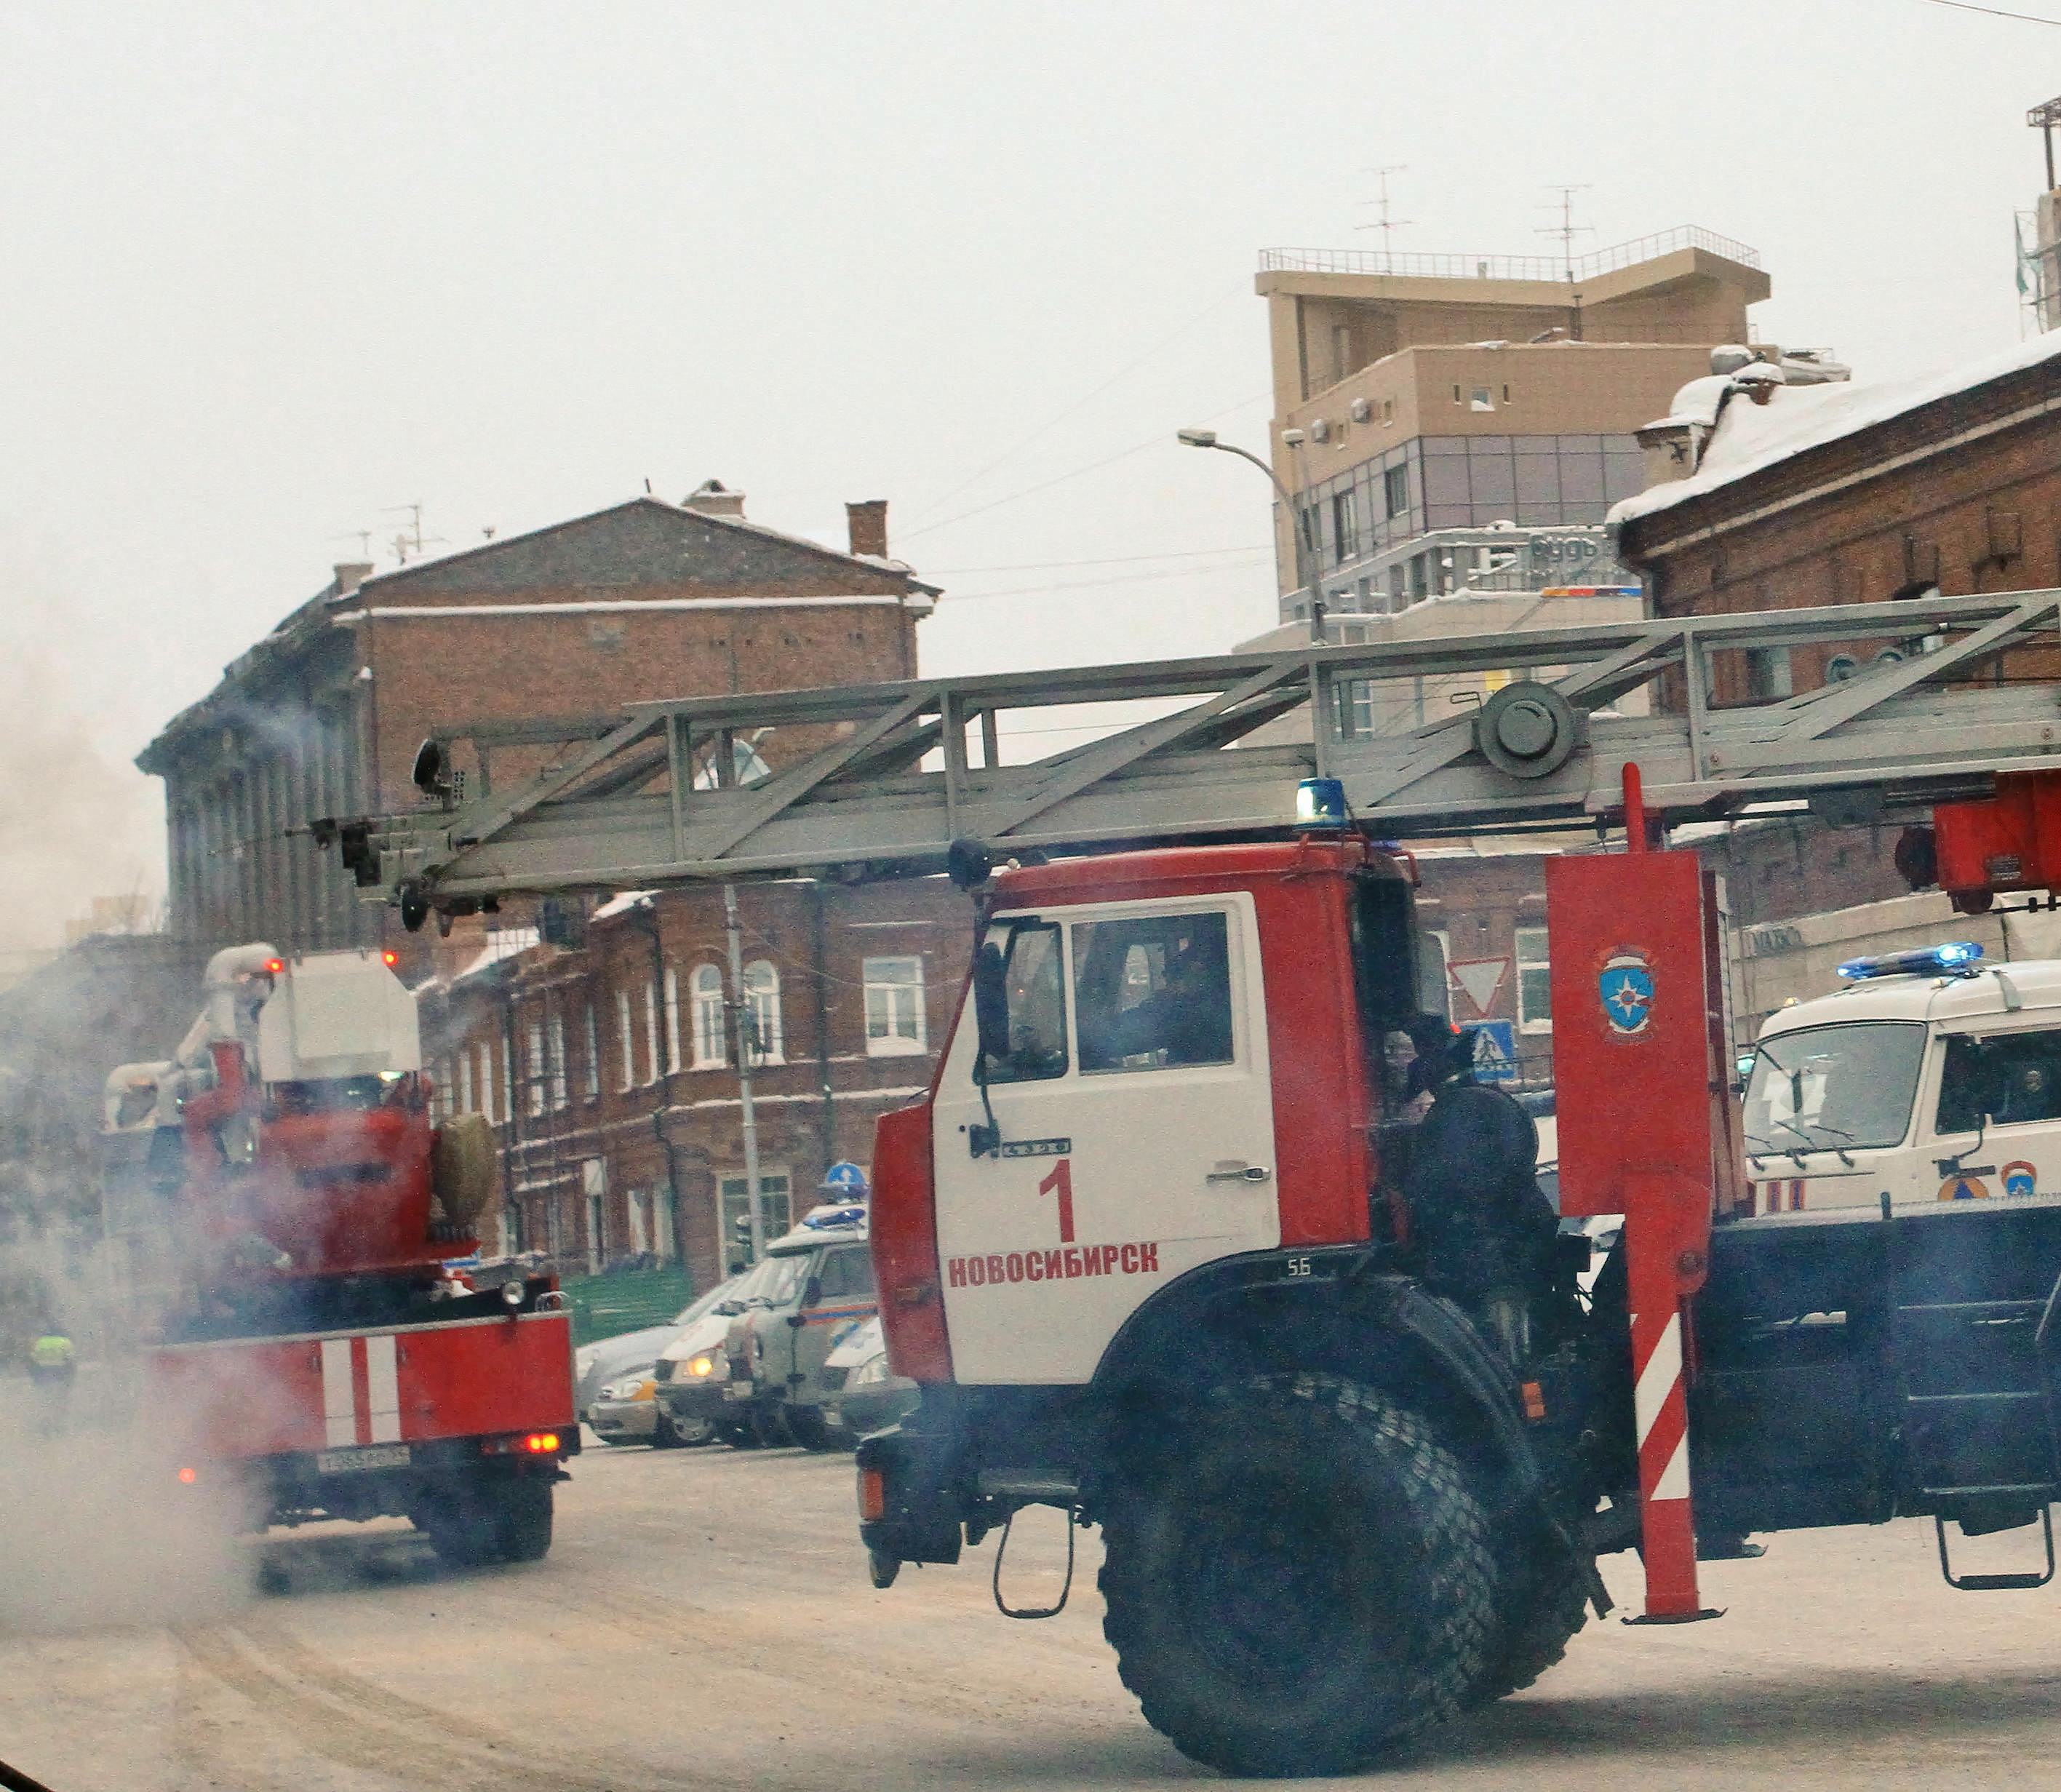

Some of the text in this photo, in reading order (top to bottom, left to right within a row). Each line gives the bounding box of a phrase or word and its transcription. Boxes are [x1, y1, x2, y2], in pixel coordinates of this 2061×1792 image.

[1040, 1159, 1075, 1242] 1
[948, 1243, 1158, 1287] НОВОСИБИРСК
[1288, 1257, 1311, 1276] 56
